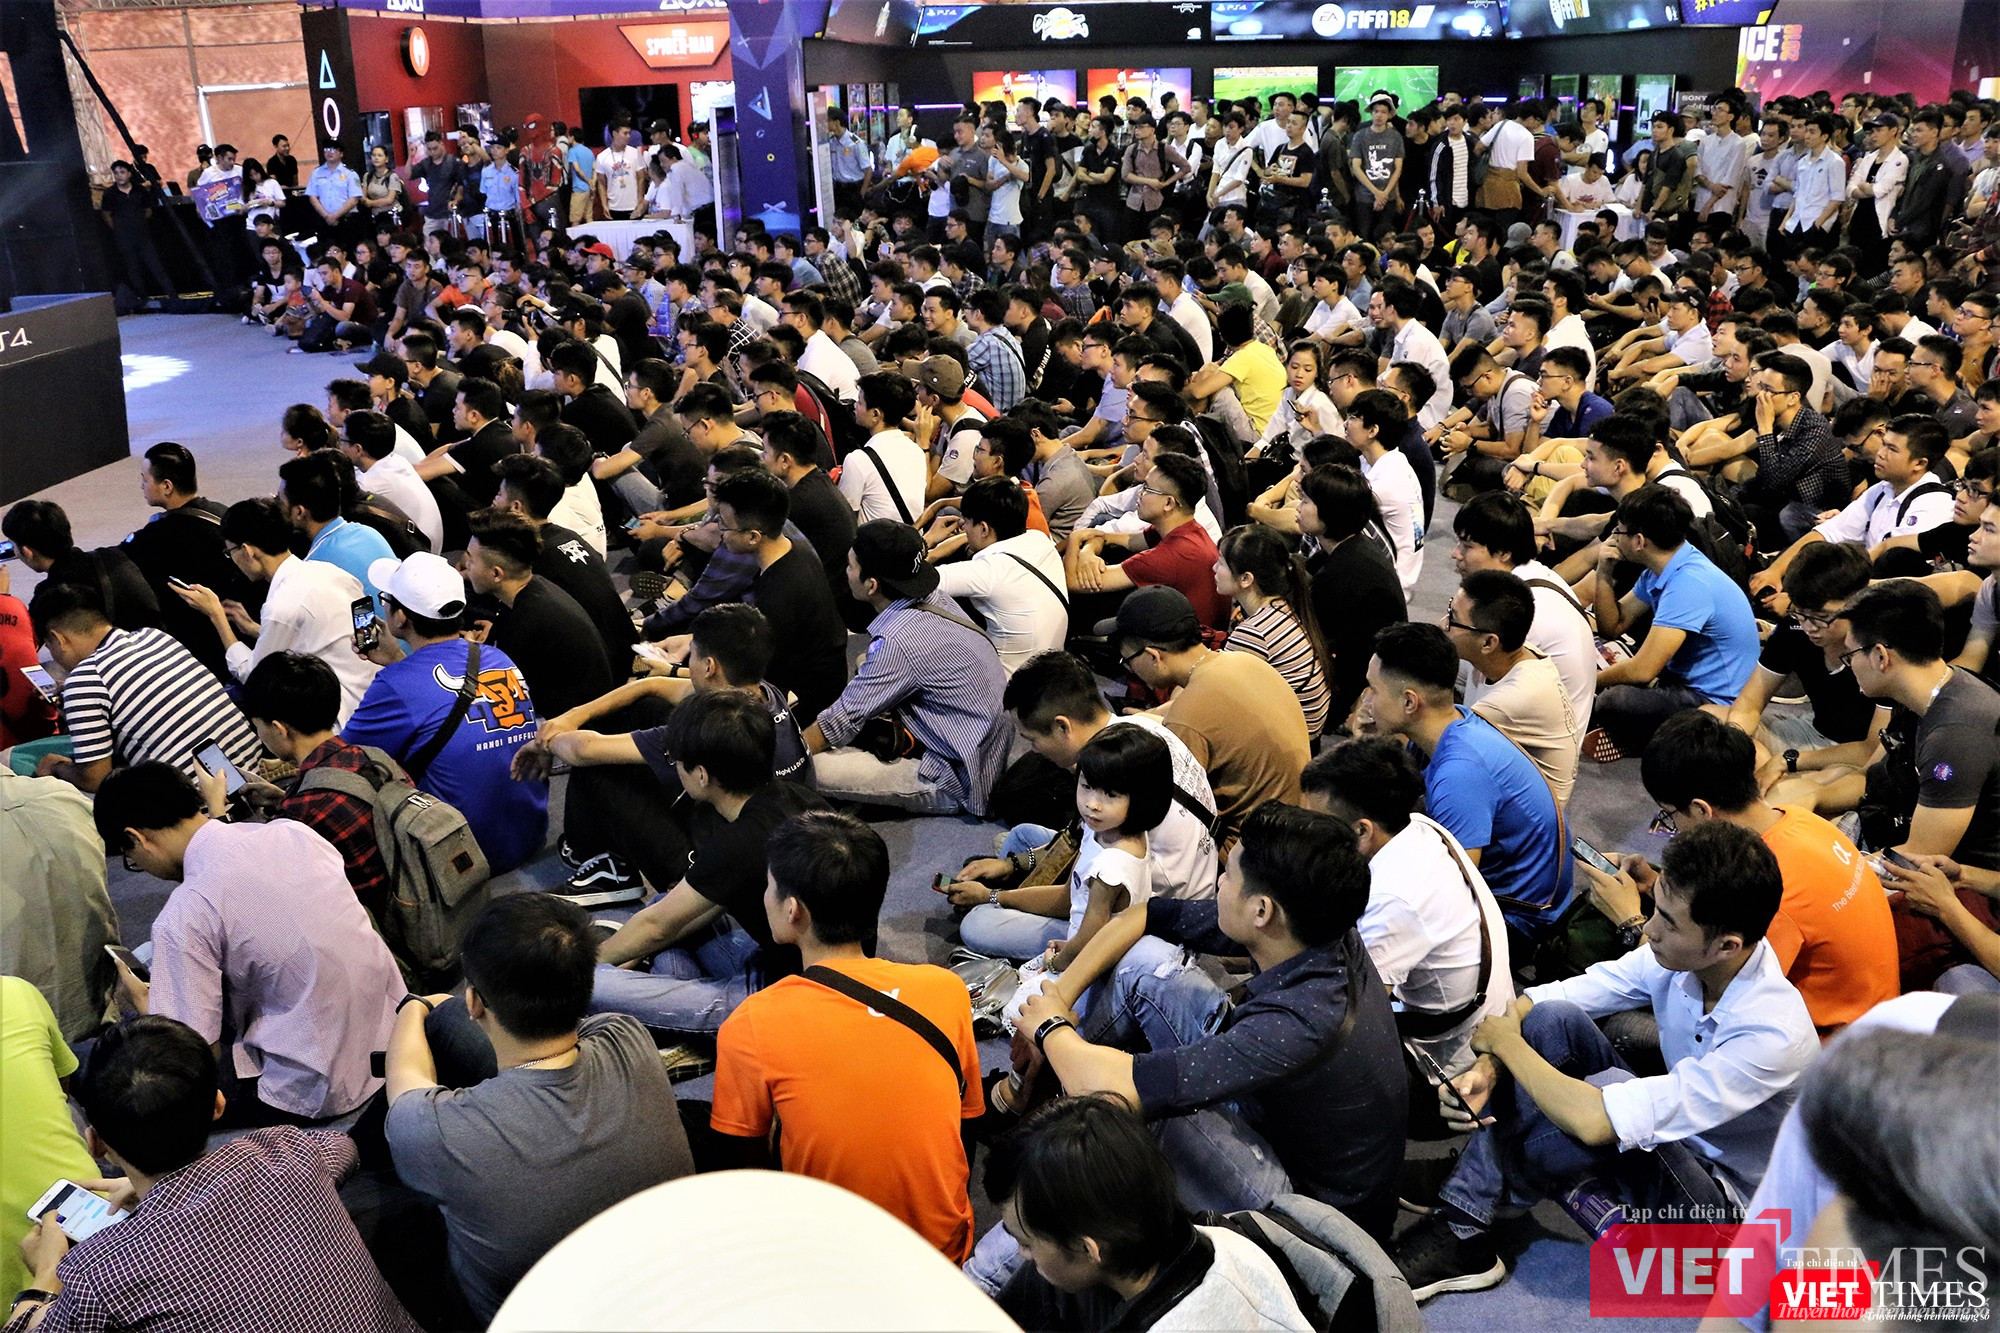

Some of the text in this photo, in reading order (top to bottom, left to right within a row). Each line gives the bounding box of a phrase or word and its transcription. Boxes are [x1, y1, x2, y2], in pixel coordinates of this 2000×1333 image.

[646, 35, 714, 56] SPIDER-MAN
[1779, 24, 1803, 62] 2018
[1681, 94, 1708, 102] SONY
[476, 738, 503, 752] HANOI
[1831, 896, 1848, 912] The
